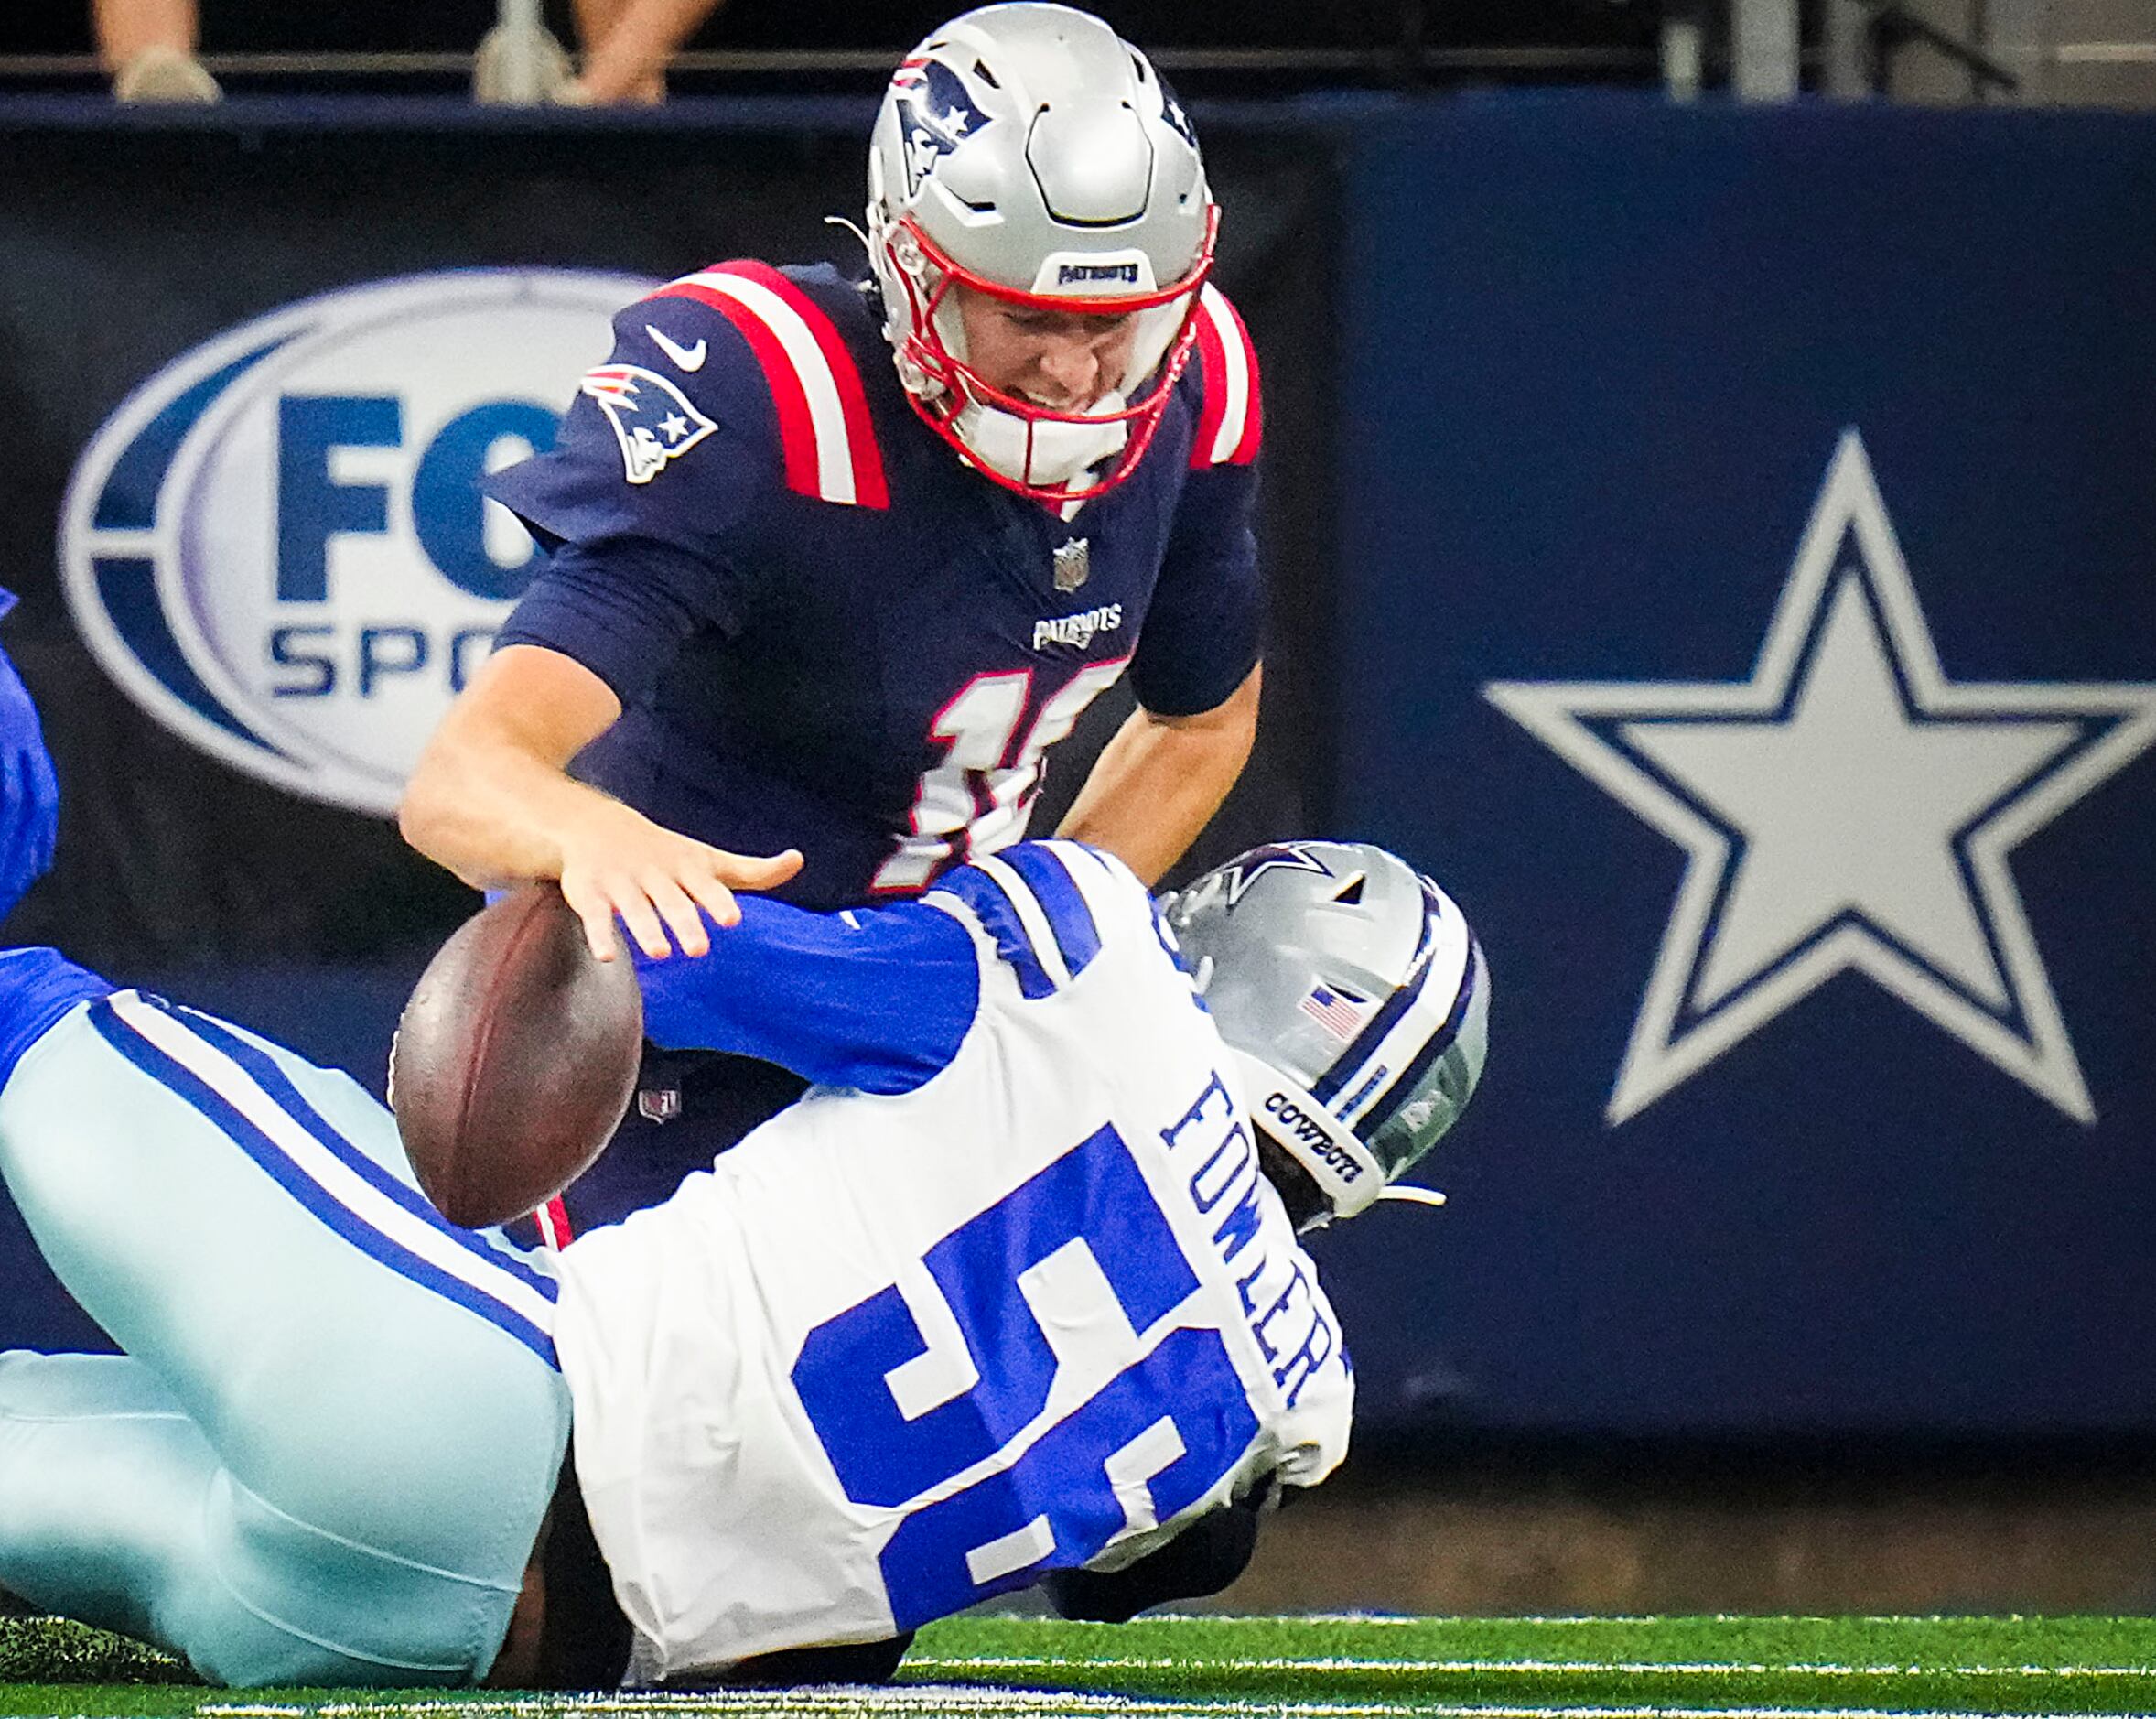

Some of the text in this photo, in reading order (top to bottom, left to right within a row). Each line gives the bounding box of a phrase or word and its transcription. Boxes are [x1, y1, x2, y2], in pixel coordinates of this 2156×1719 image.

[1159, 1068, 1332, 1411] FOWLER
[1265, 1092, 1364, 1183] COWBOYS
[790, 1120, 1260, 1634] 56
